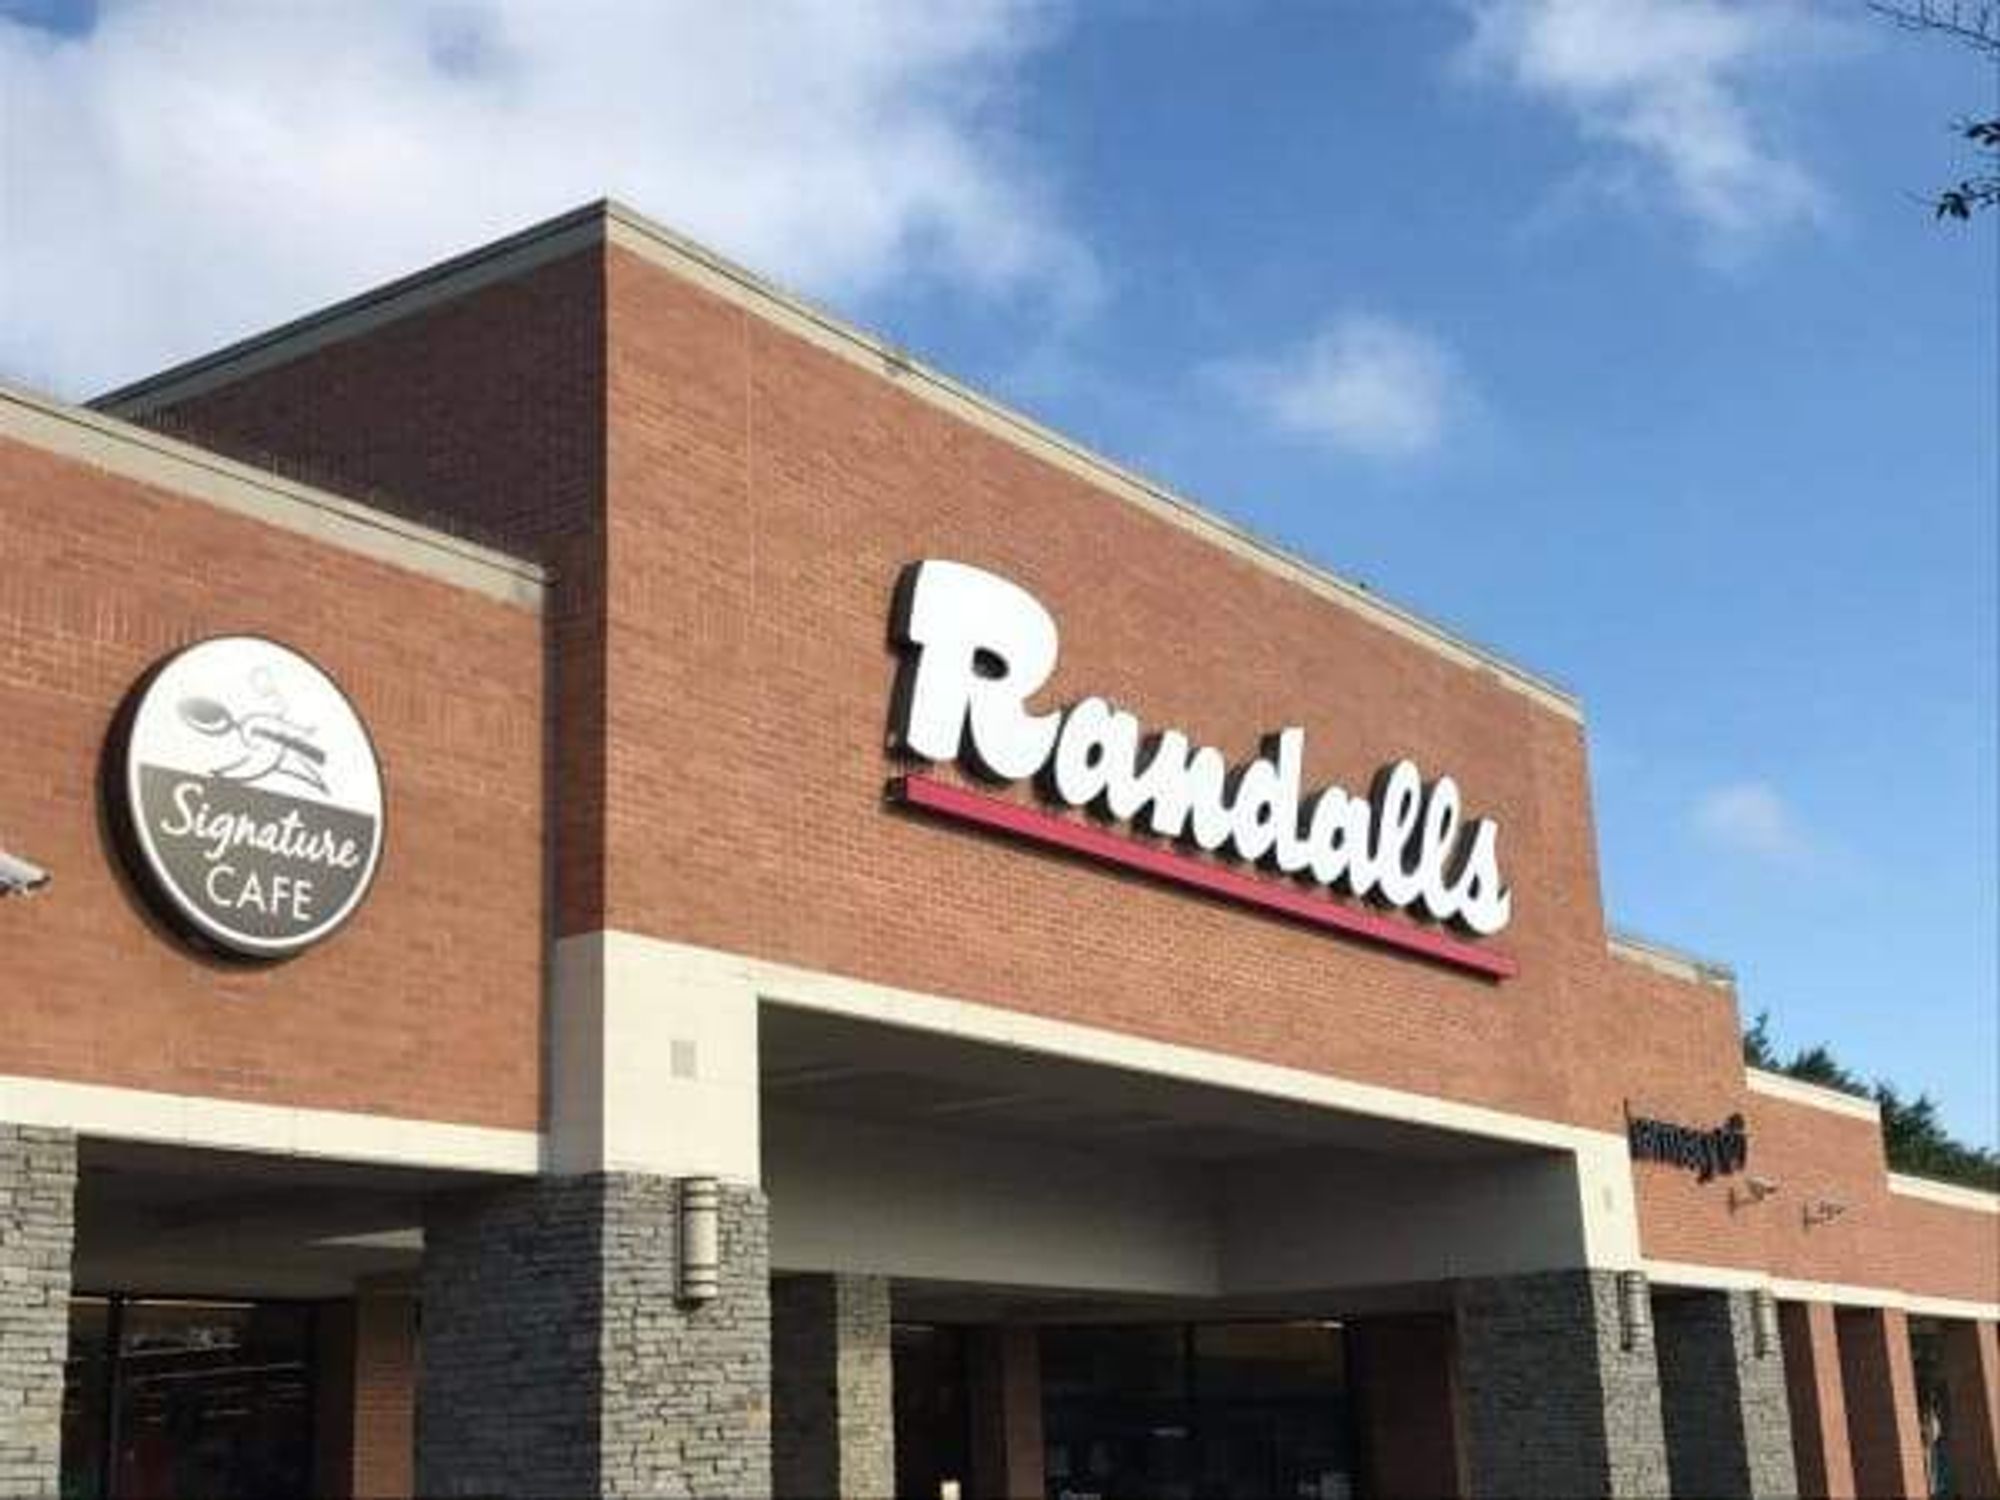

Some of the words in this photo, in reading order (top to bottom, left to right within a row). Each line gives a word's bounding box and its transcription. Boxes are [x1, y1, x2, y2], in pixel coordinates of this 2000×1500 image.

[906, 559, 1511, 934] Randalls
[160, 782, 359, 868] Signature
[206, 865, 313, 921] CAFE
